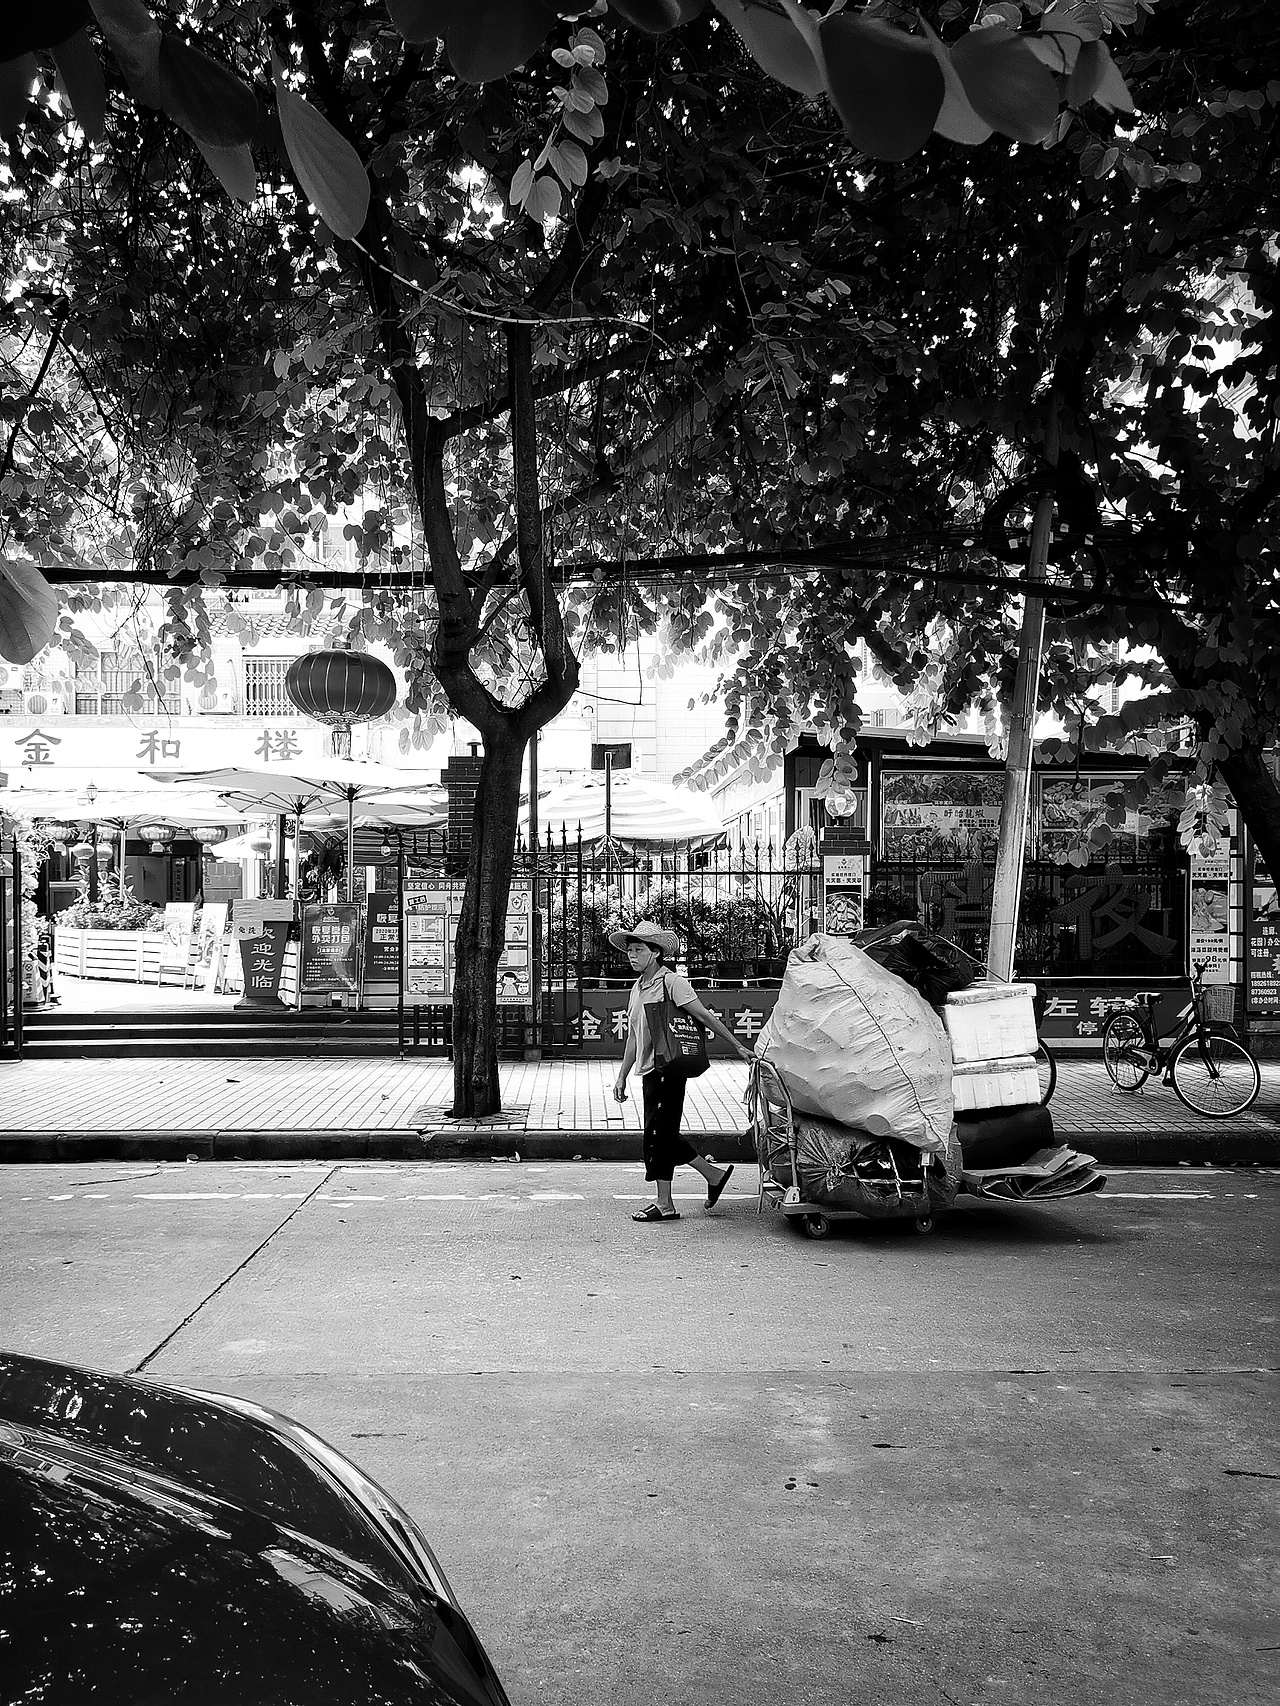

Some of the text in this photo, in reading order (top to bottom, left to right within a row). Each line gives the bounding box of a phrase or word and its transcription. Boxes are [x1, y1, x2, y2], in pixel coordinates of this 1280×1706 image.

[14, 728, 303, 766] 金和楼
[311, 934, 350, 944] 外卖打包
